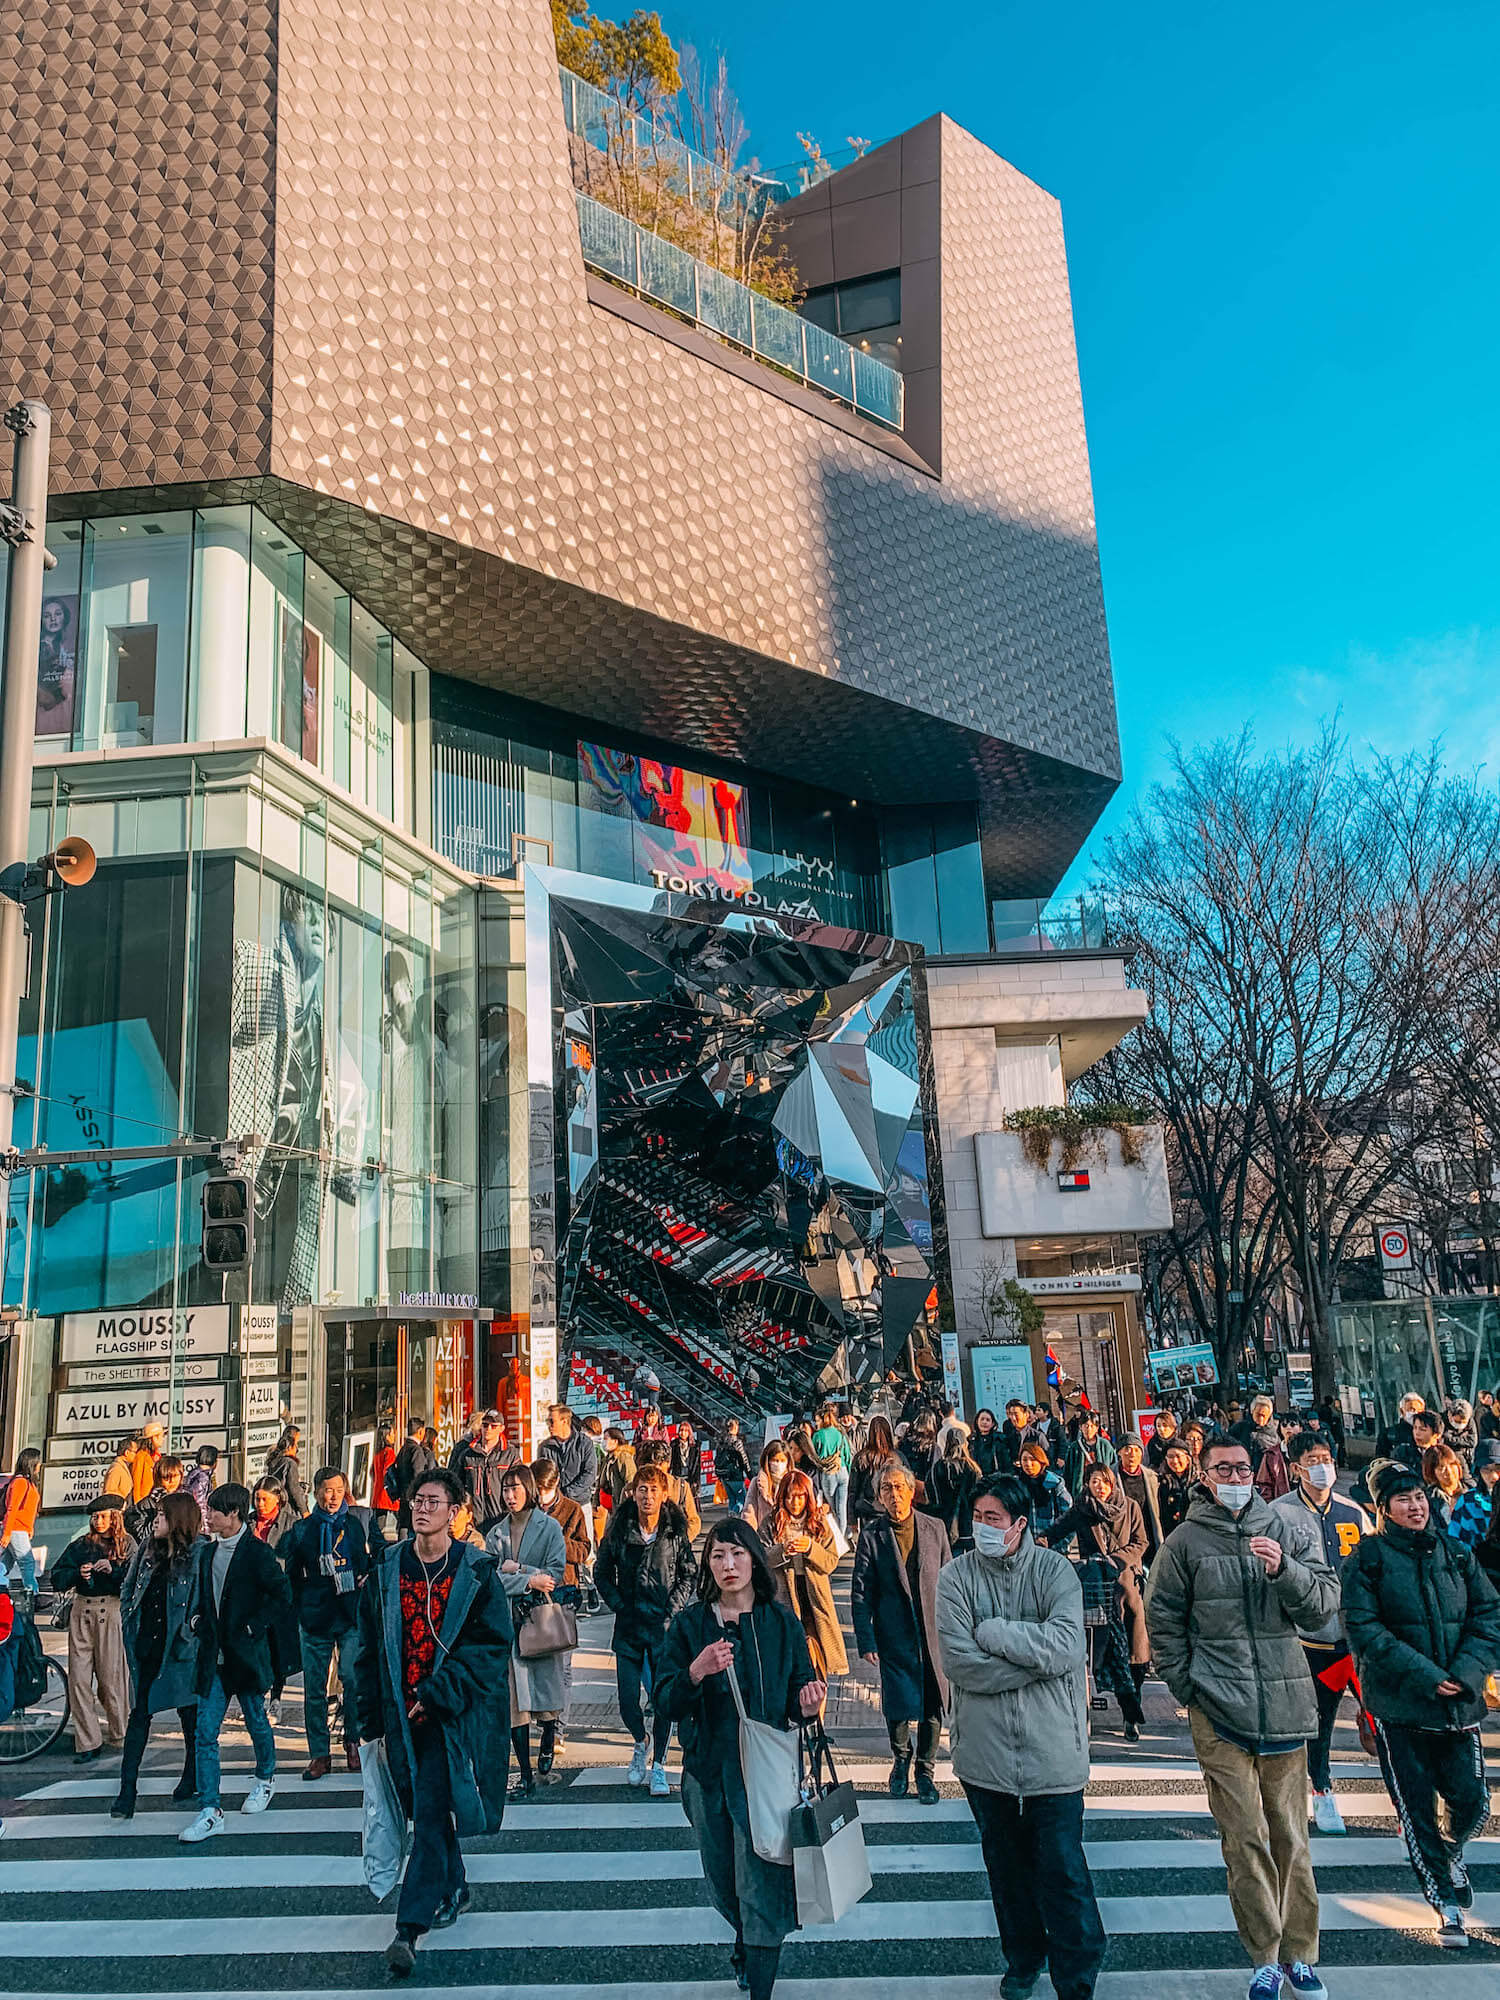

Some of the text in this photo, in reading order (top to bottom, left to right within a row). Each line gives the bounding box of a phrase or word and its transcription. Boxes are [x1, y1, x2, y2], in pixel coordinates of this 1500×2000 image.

[783, 849, 834, 881] NYX
[651, 869, 822, 922] TOKYU PLAZA
[1387, 1238, 1403, 1251] 50
[1032, 1280, 1122, 1291] TOMMY HILFIGER
[97, 1314, 195, 1338] MOUSSY
[243, 1317, 275, 1328] MOUSSY
[96, 1338, 195, 1354] FLAGSHIP SHOP
[84, 1371, 106, 1381] The
[249, 1388, 274, 1404] AZUL
[66, 1404, 110, 1421] AZUL
[117, 1403, 138, 1418] BY
[143, 1398, 215, 1417] MOUSSY
[438, 1402, 468, 1428] SAE
[81, 1436, 194, 1455] MOU SLY
[62, 1470, 98, 1480] RODEO
[63, 1492, 93, 1502] AVAN
[1335, 1522, 1361, 1557] P
